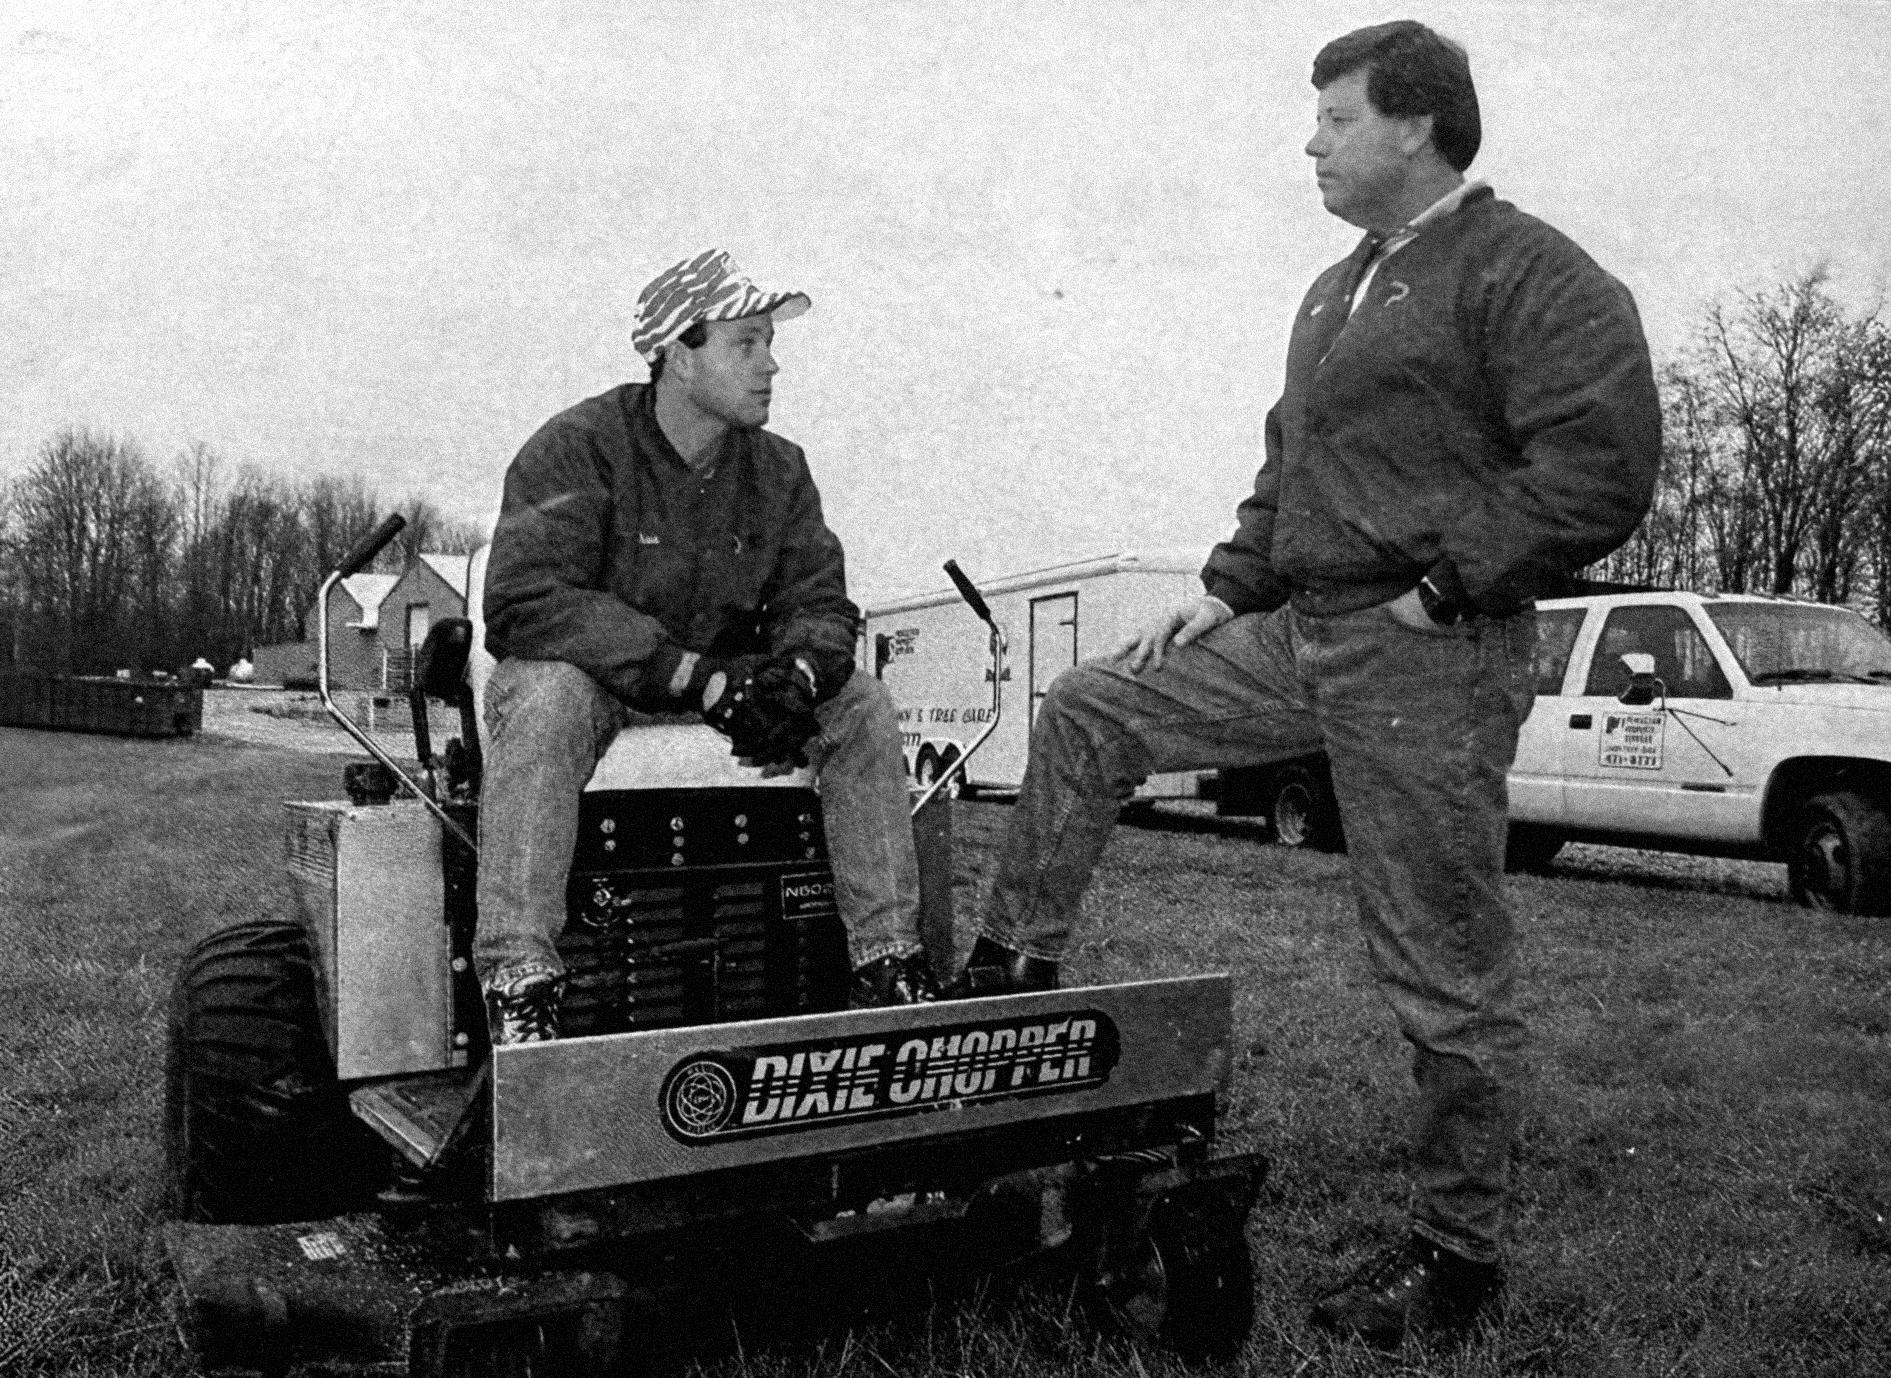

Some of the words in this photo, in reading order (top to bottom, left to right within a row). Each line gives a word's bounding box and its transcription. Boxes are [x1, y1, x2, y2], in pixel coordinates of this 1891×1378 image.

[929, 708, 958, 724] TREE
[742, 1044, 886, 1124] DIXIE
[888, 1018, 1097, 1104] CHOPPER
